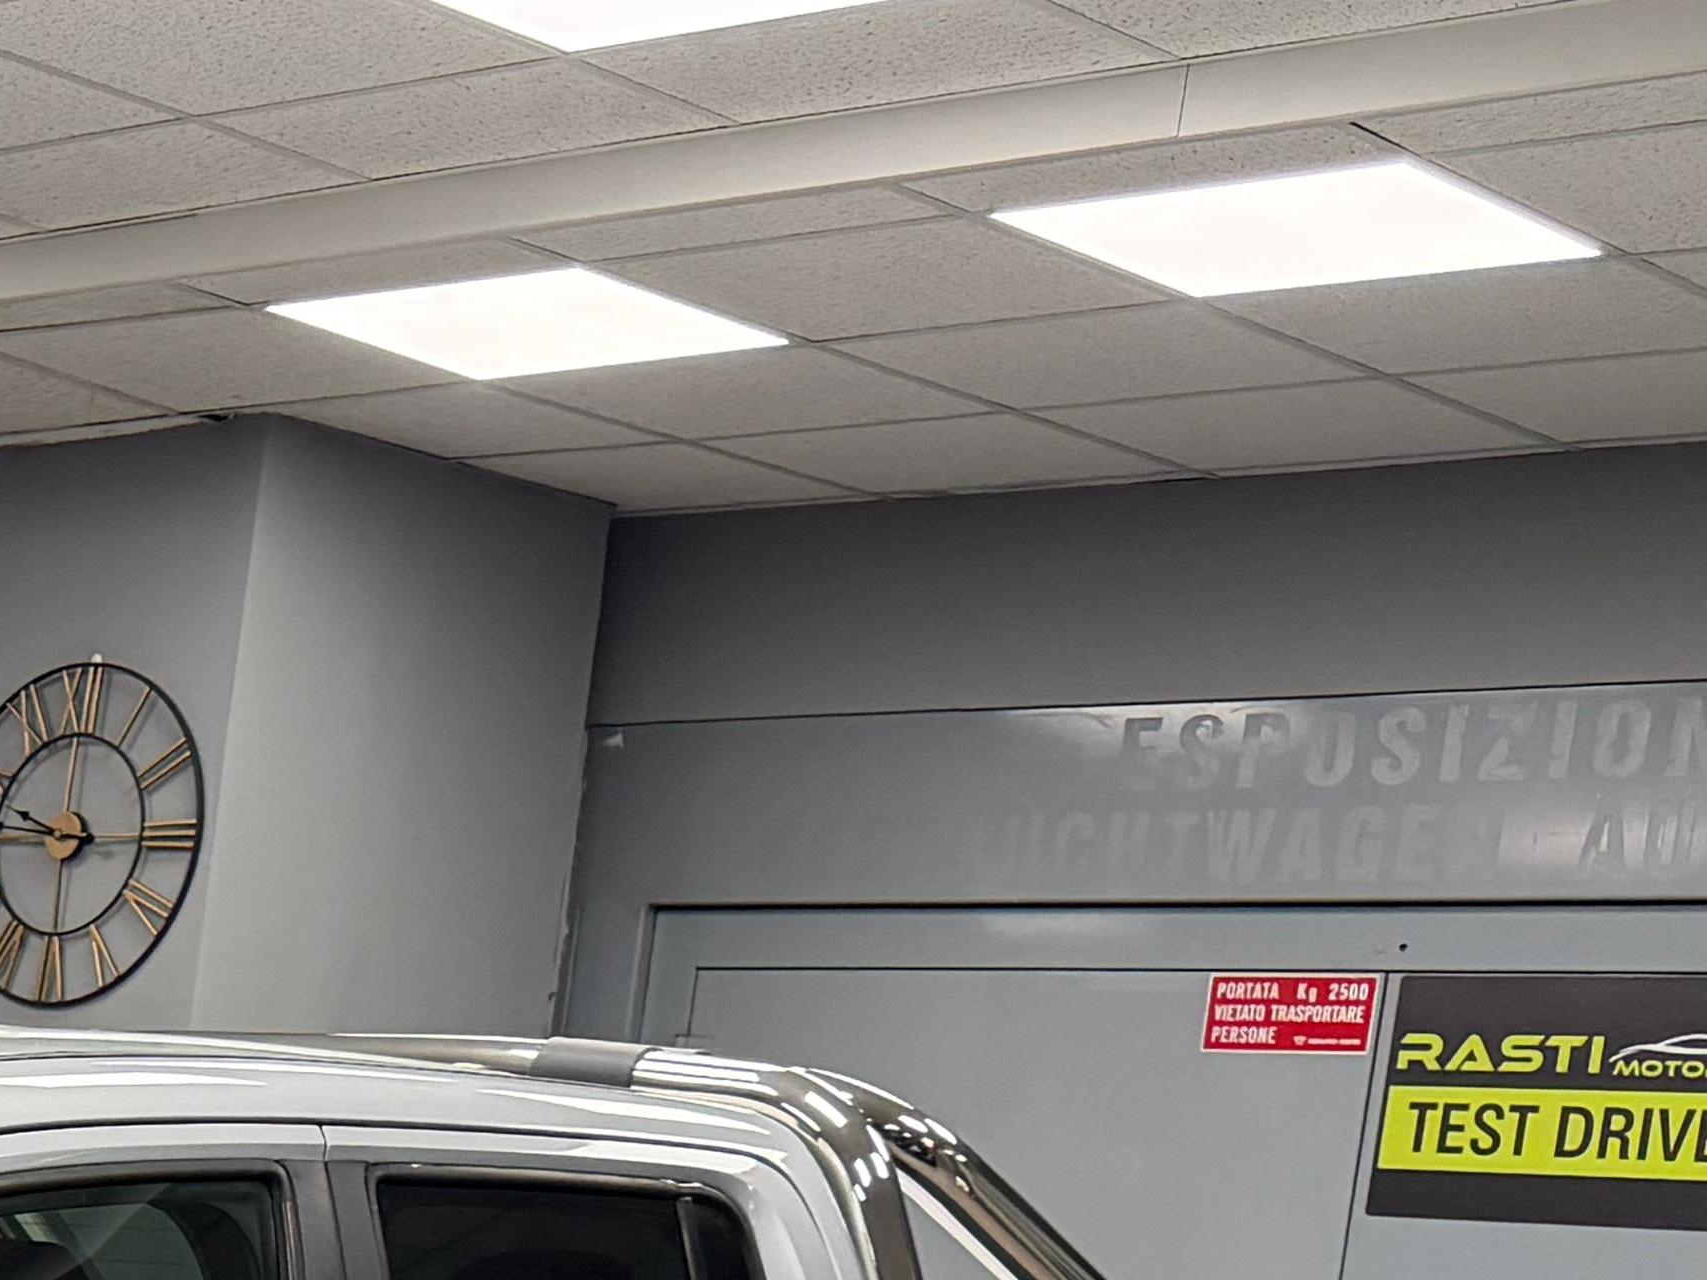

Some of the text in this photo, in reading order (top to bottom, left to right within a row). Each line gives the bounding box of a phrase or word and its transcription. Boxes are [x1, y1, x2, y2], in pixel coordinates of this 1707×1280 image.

[1216, 981, 1369, 1003] PORTATA Kg 2500
[1214, 1003, 1365, 1024] VIETATO TRASPORTARE
[1210, 1026, 1277, 1045] PERSONE
[1396, 1033, 1707, 1079] RASTI MOTO
[1409, 1101, 1541, 1157] TEST
